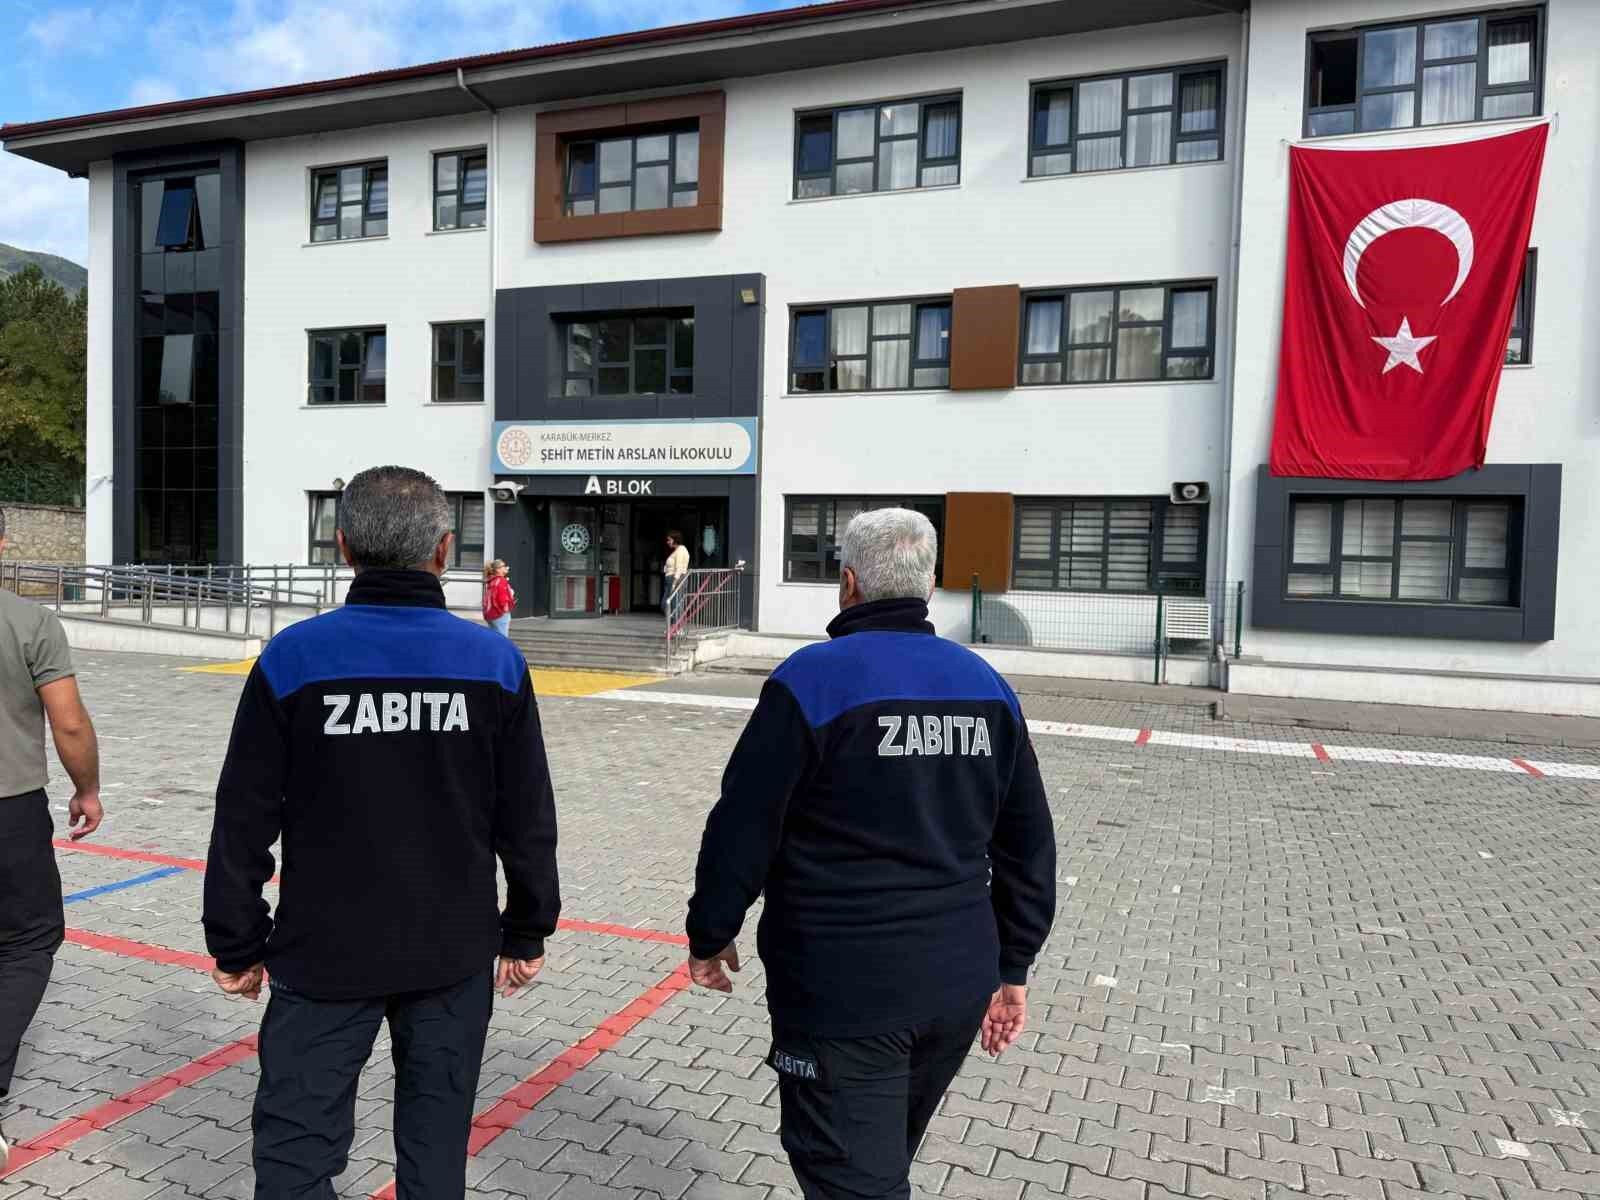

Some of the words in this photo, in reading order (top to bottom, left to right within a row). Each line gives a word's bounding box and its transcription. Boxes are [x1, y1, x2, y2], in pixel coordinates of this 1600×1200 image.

[541, 445, 574, 464] ŞEHİT
[576, 445, 615, 460] METİN
[617, 447, 666, 460] ARSLAN
[669, 445, 732, 460] İLKOKULU
[584, 475, 602, 495] A
[606, 480, 653, 495] BLOK
[323, 692, 470, 735] ZABITA
[878, 715, 992, 756] ZABITA
